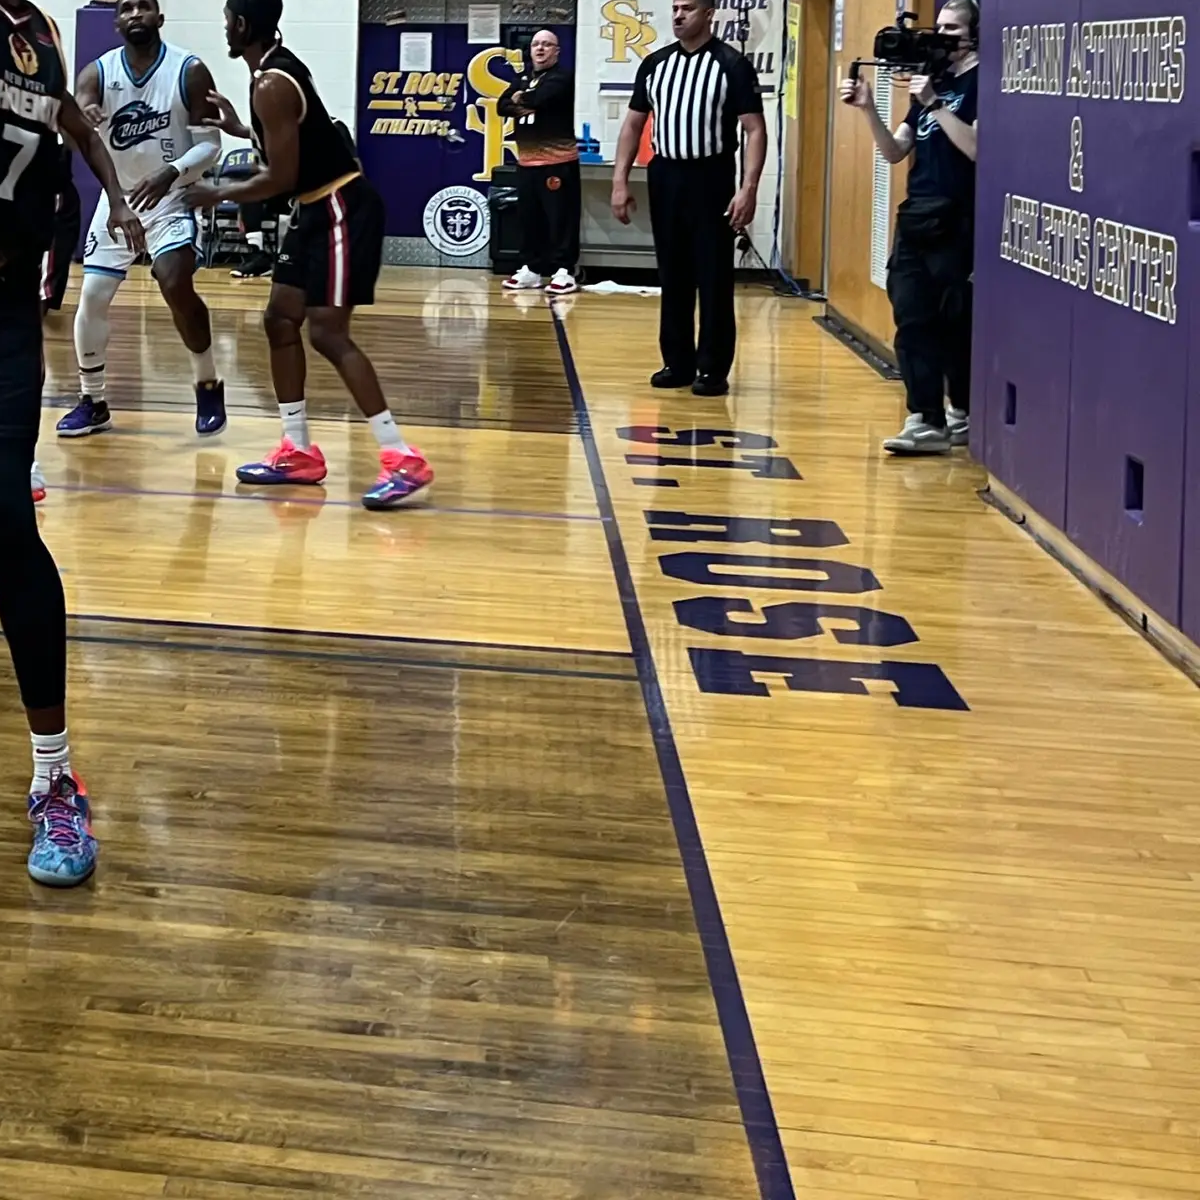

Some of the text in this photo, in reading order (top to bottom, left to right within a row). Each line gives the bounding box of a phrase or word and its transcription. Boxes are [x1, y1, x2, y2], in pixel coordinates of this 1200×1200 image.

[369, 71, 463, 96] ST. ROSE
[1066, 16, 1186, 103] ACTIVITIES
[116, 113, 170, 138] BREAKS
[370, 118, 450, 137] ATHLETICS
[1069, 116, 1084, 192] &
[1000, 193, 1177, 325] ATHLETICS CENTER
[615, 425, 804, 487] ST.
[643, 509, 971, 712] ROSE
